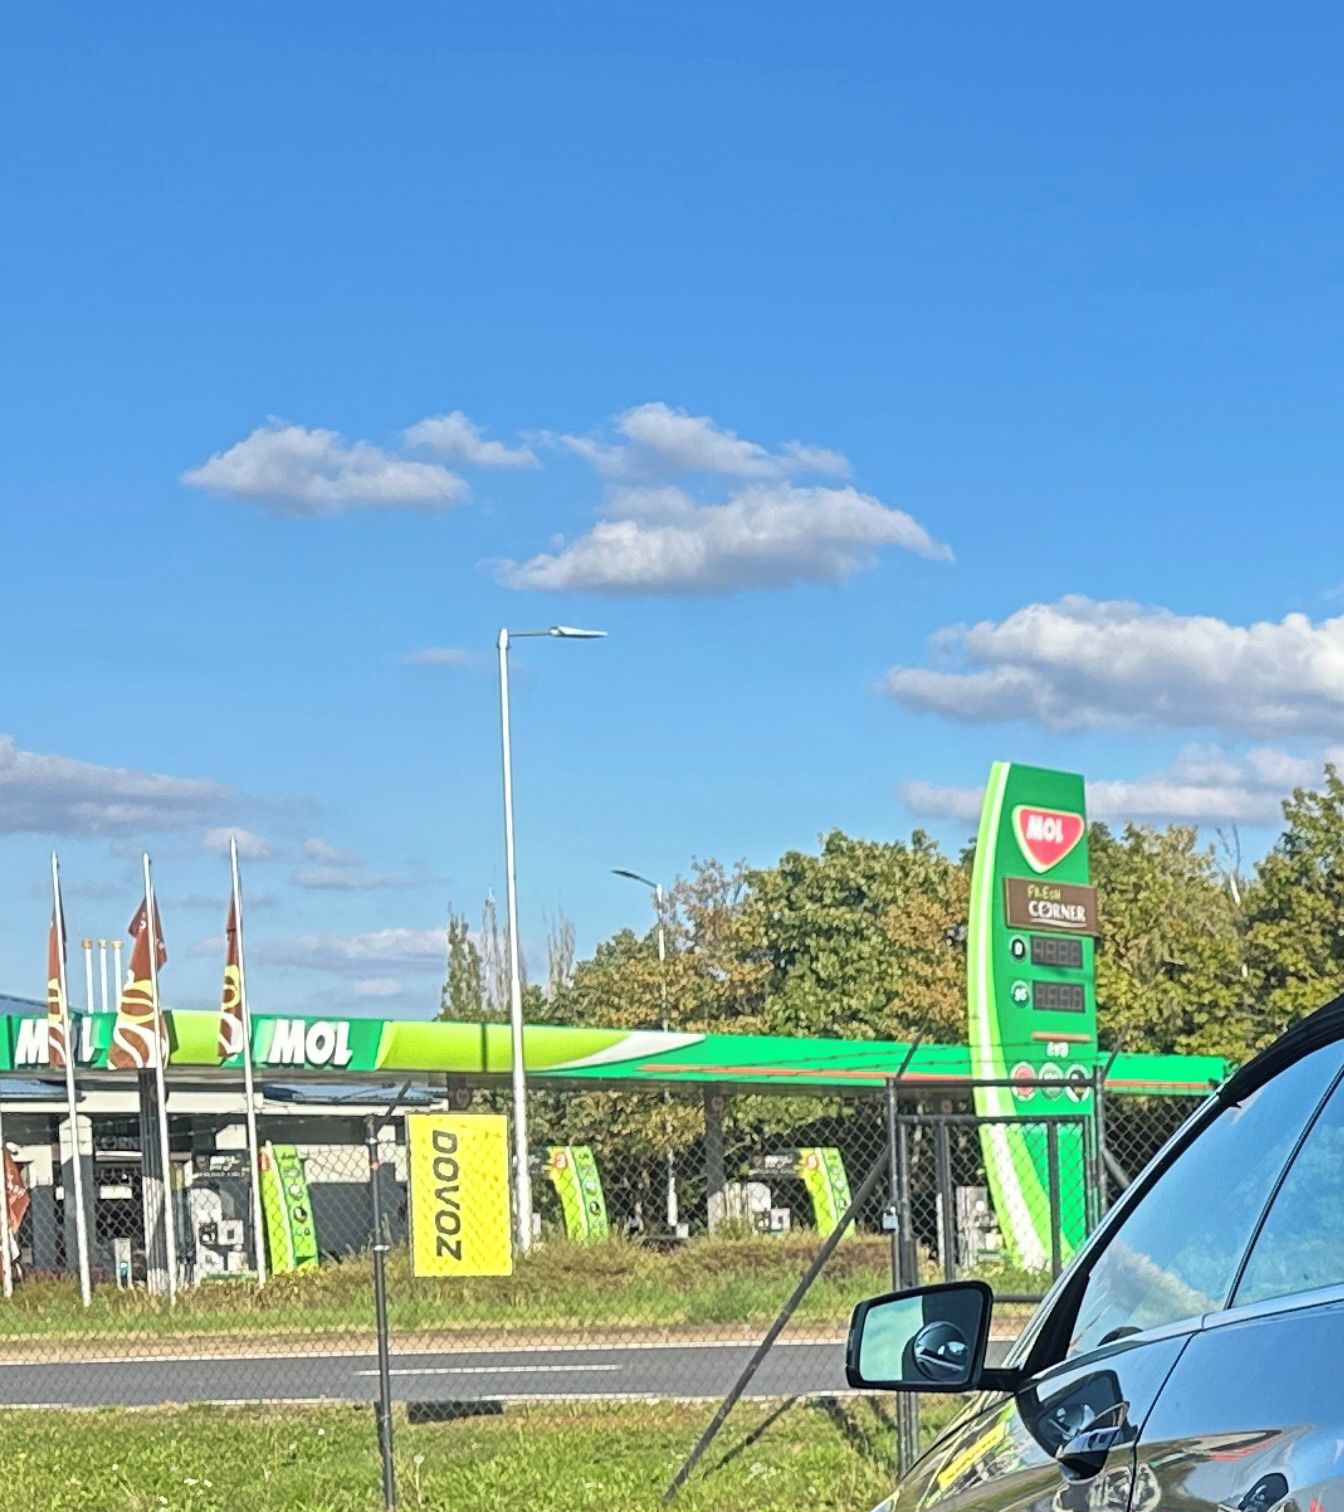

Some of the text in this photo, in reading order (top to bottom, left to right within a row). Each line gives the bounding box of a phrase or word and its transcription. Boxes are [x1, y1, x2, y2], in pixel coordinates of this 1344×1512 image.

[1026, 814, 1064, 844] MOL
[1028, 900, 1086, 922] CORNER
[268, 1018, 353, 1066] MOL
[432, 1129, 463, 1262] DOVOZ
